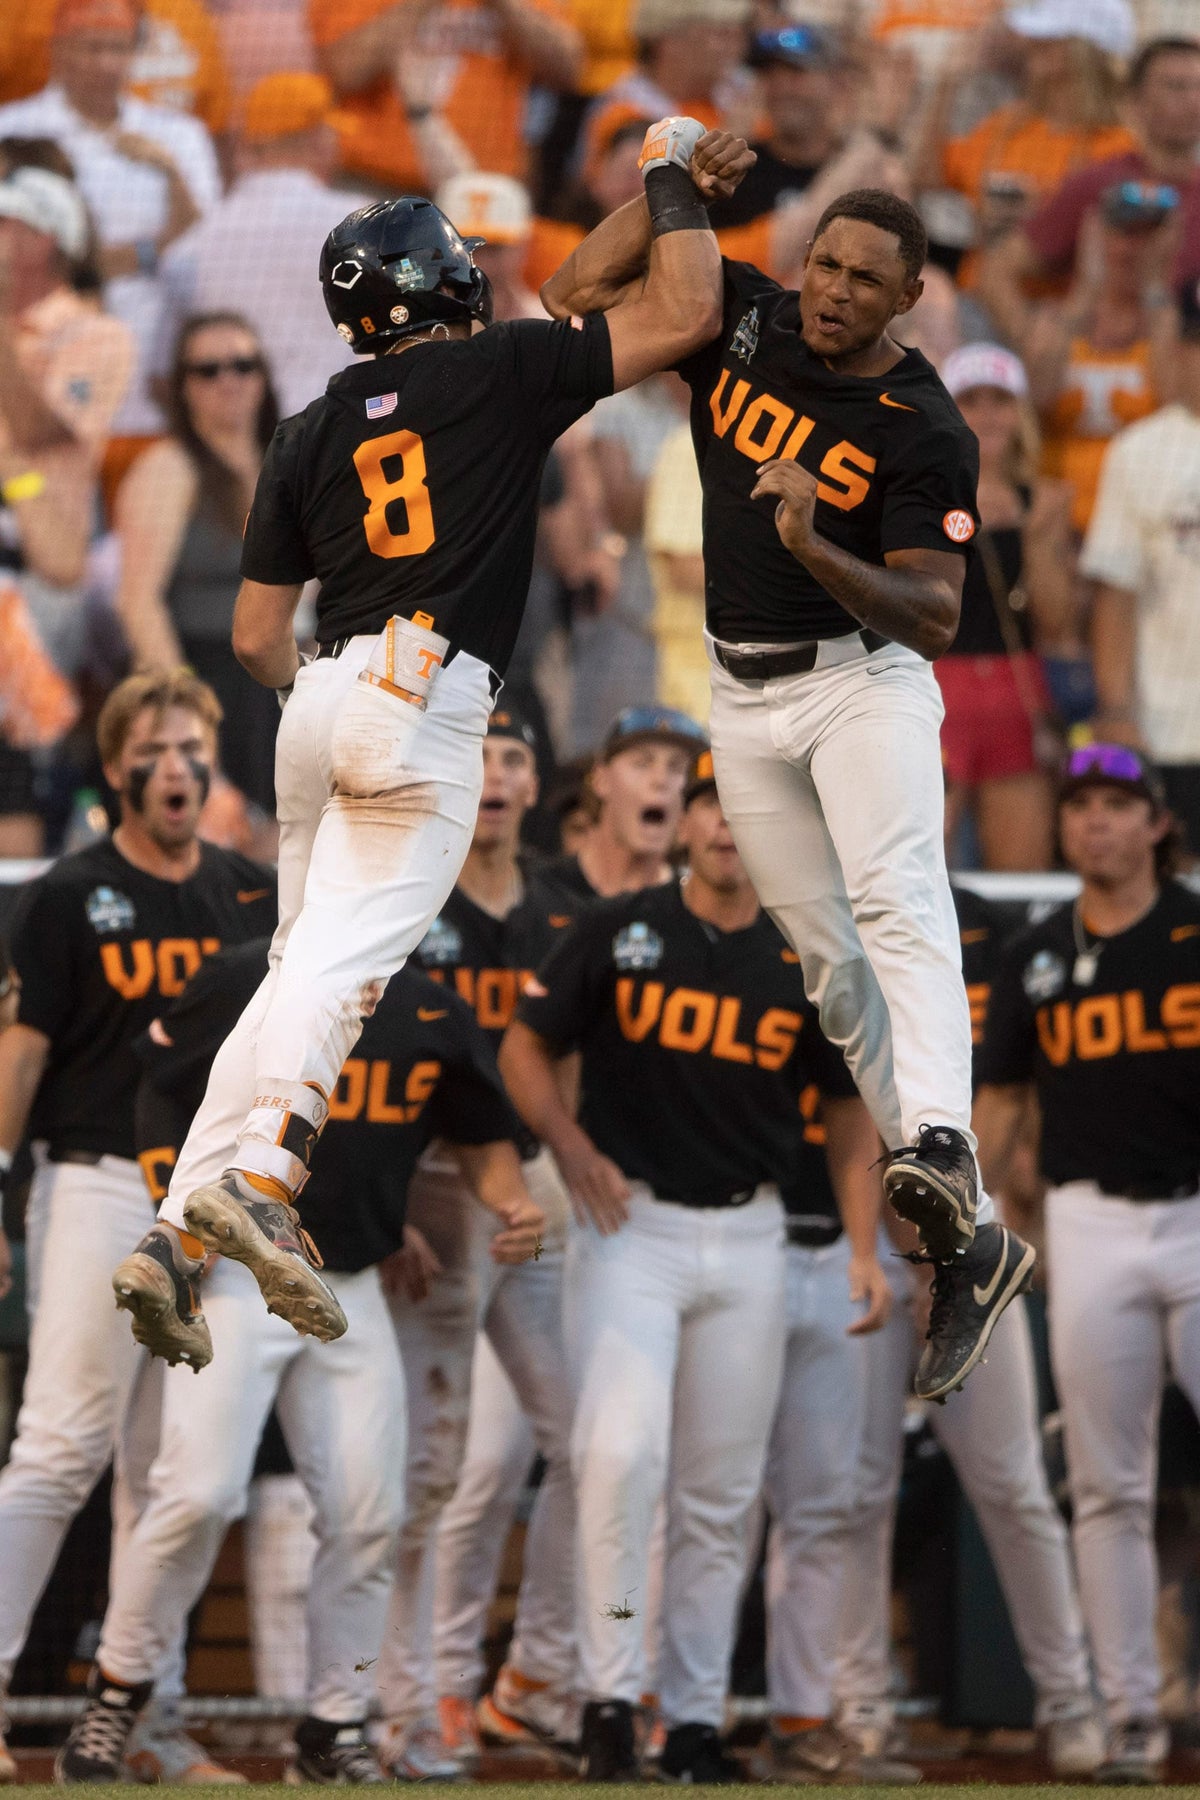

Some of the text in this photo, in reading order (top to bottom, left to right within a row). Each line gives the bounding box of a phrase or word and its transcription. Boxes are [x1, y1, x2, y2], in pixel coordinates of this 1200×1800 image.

[361, 316, 376, 334] 8
[1065, 362, 1143, 437] T
[352, 429, 436, 559] 8
[945, 511, 973, 540] SEC
[417, 648, 442, 679] T
[100, 938, 220, 999] VO
[615, 977, 804, 1073] VOLS
[1035, 982, 1200, 1068] VOLS
[252, 1095, 293, 1110] EERS
[329, 1056, 442, 1124] OLS
